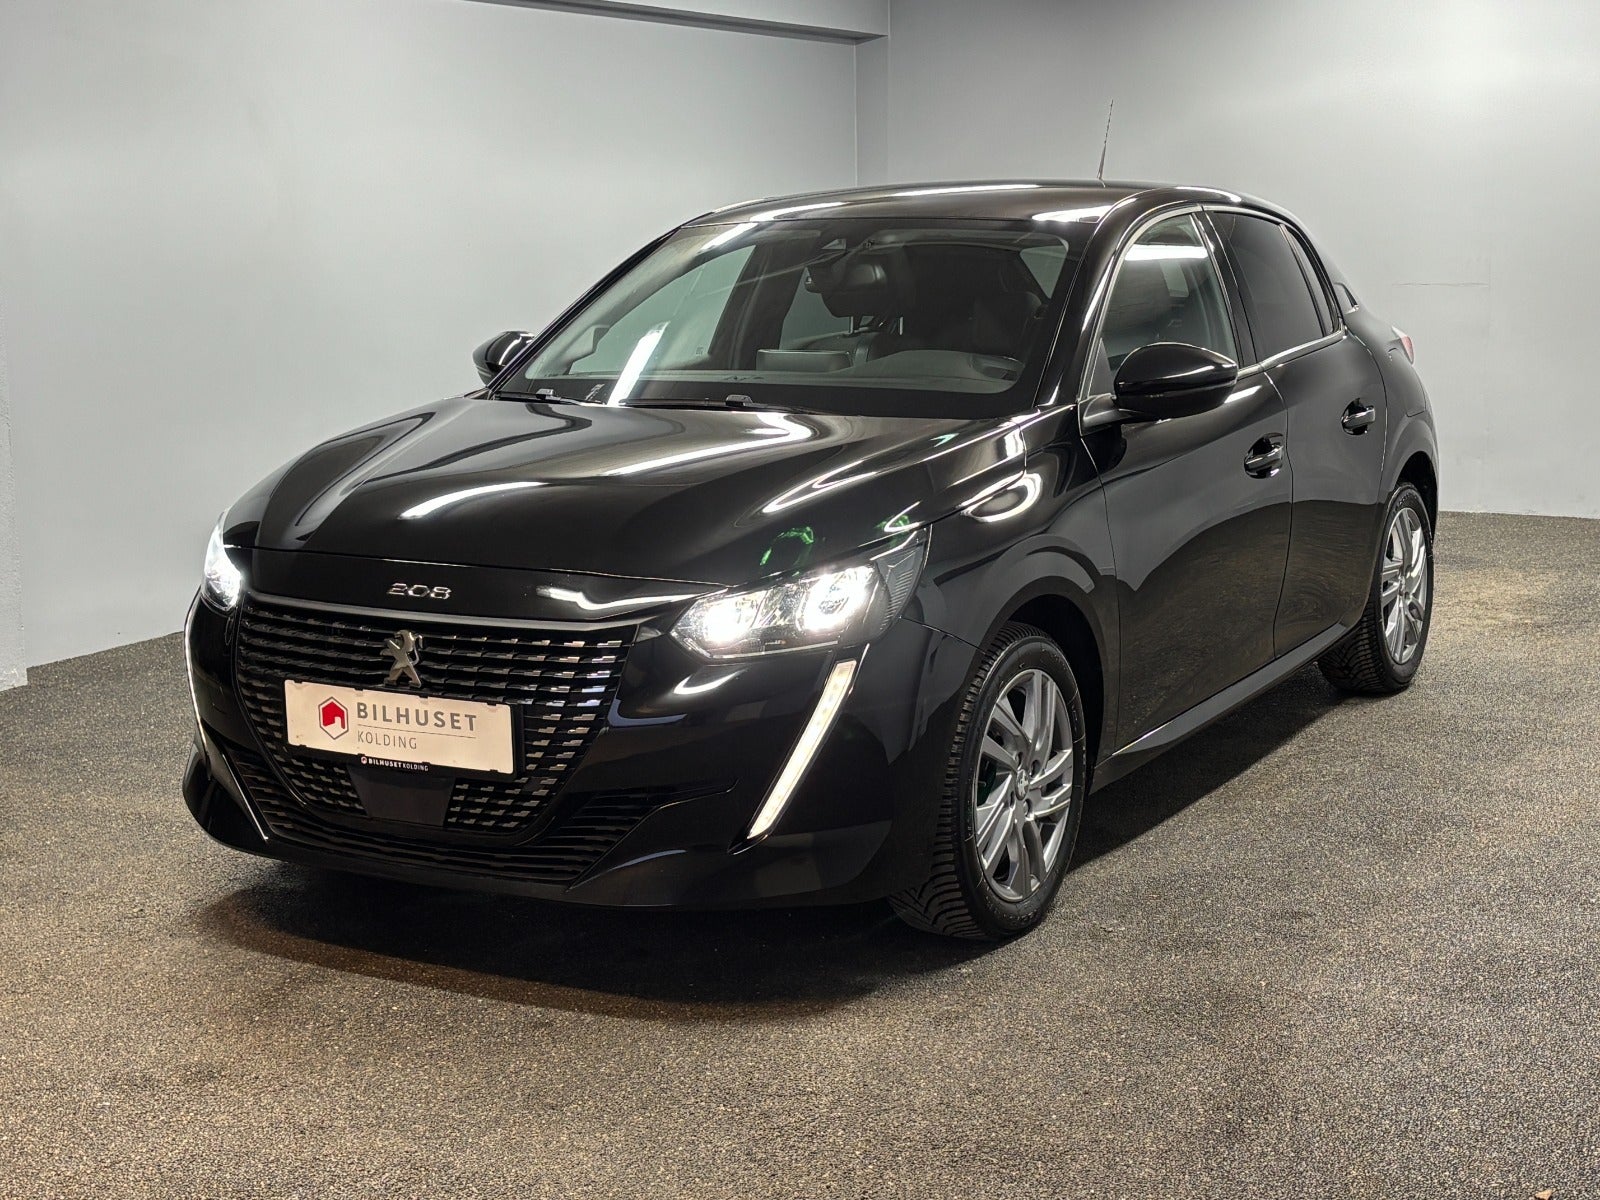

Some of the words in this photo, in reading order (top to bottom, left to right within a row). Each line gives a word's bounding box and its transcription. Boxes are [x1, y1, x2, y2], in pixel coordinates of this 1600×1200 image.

[387, 583, 452, 599] 208
[357, 702, 477, 731] BILHUSET
[358, 730, 417, 750] KOLDING
[368, 758, 402, 768] BILHUSET
[402, 763, 429, 771] KOLDING
